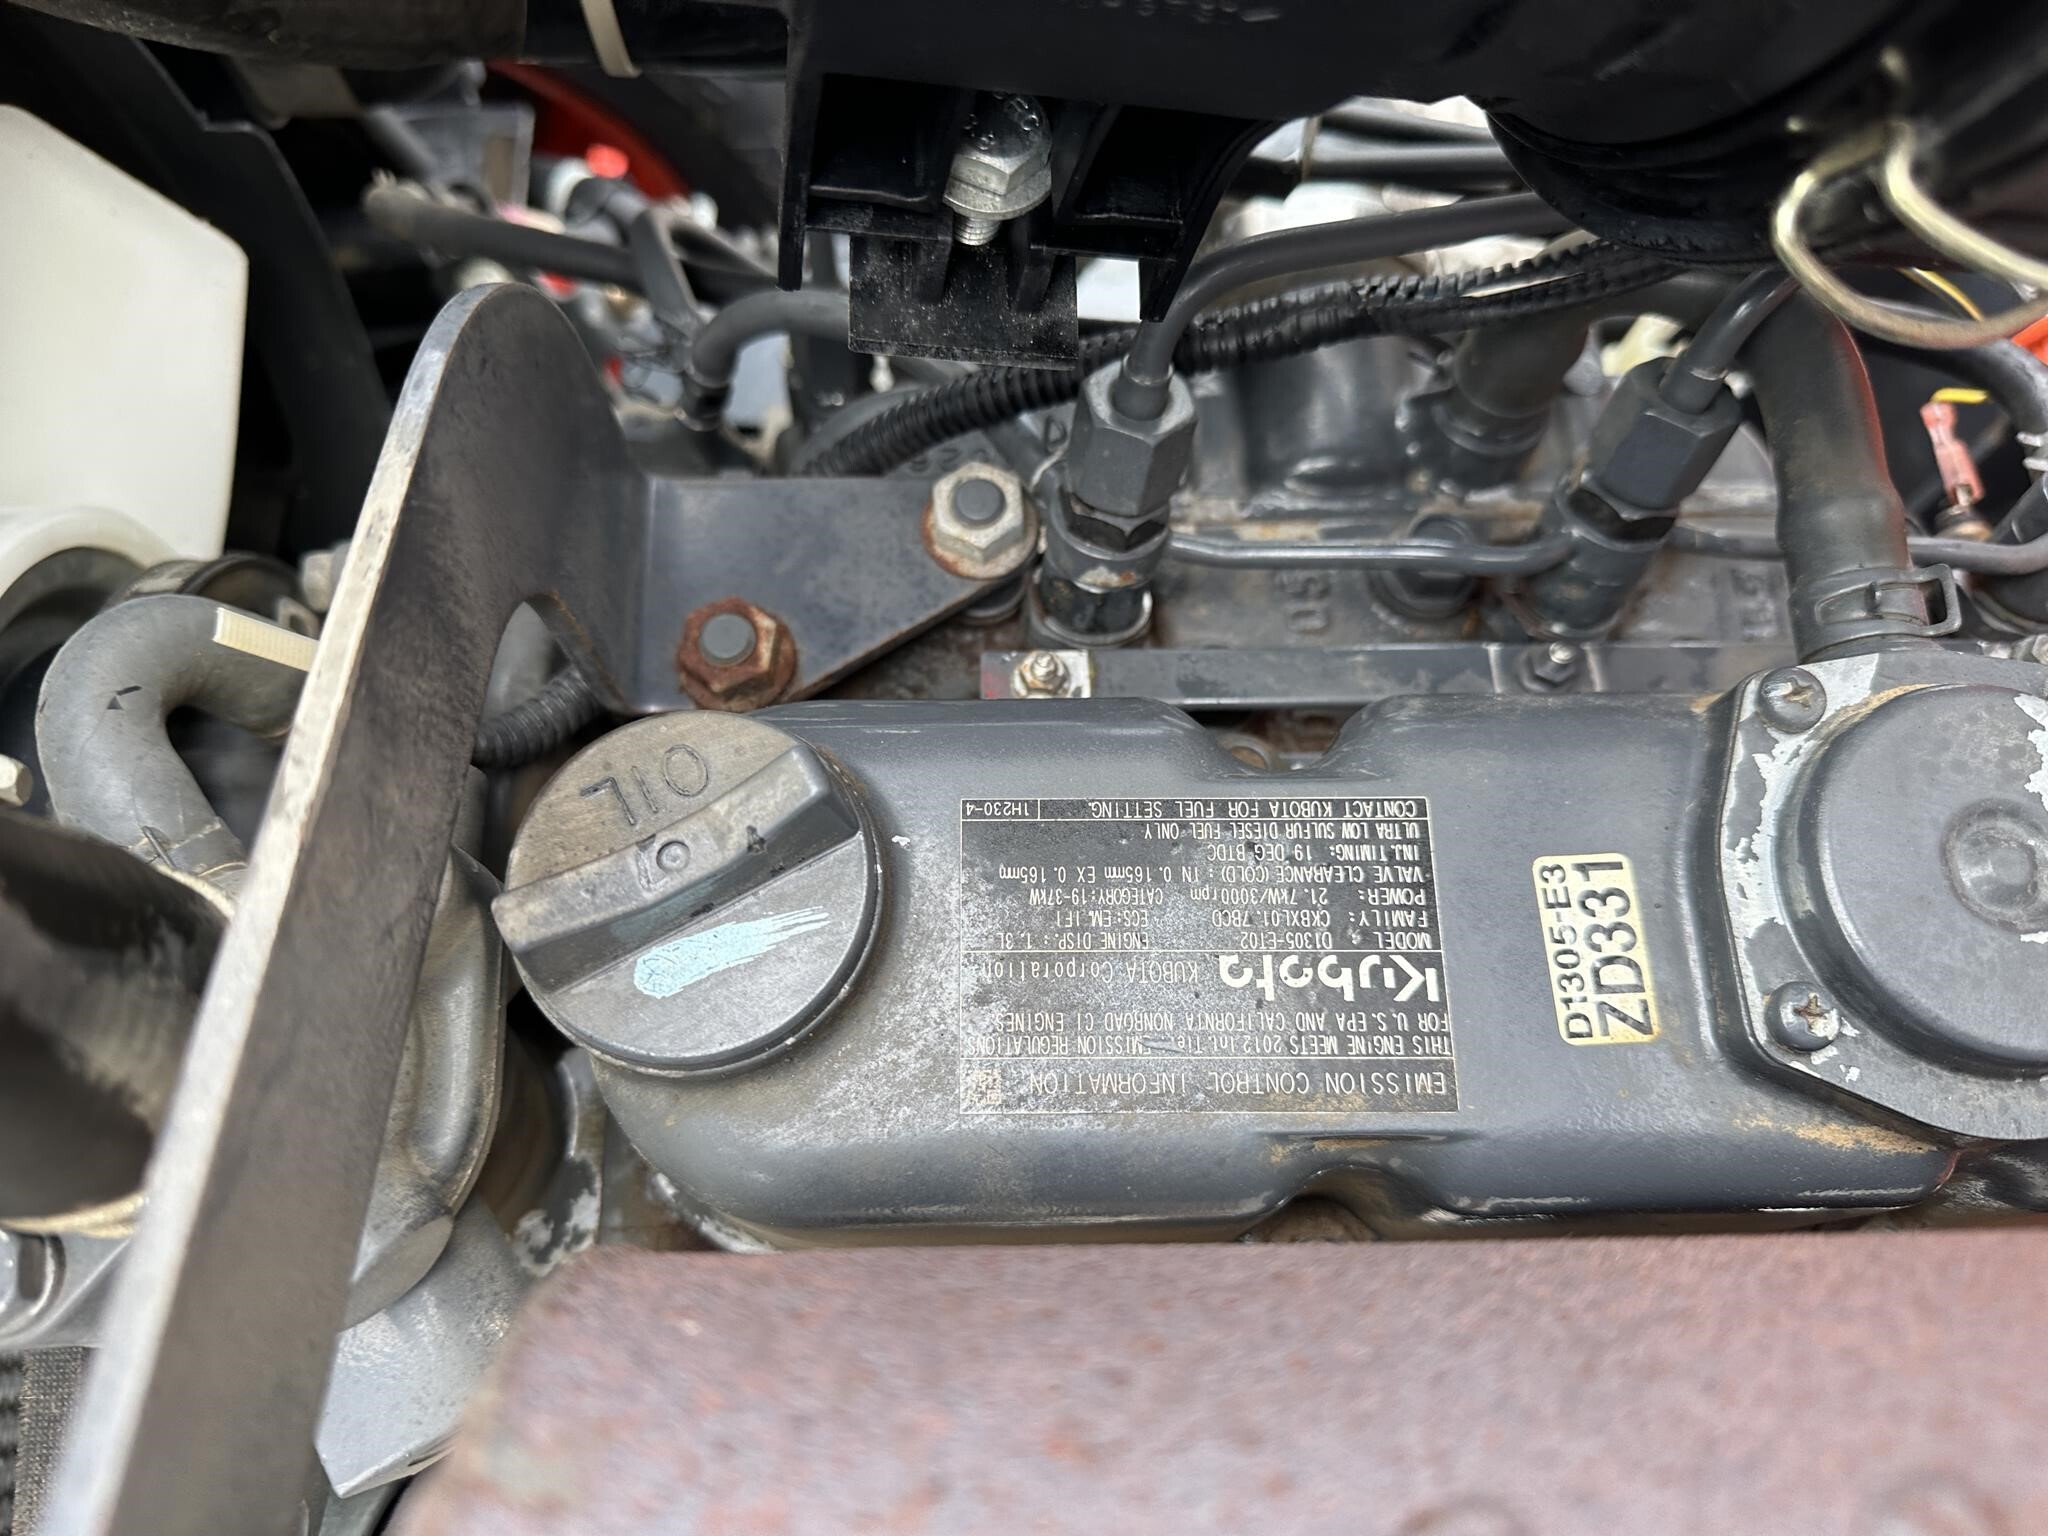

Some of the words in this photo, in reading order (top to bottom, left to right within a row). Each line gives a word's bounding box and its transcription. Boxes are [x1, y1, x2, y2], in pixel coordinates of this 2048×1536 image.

[580, 743, 709, 826] OIL
[964, 801, 1031, 817] 1H230-4
[1174, 799, 1215, 819] FUEL
[1227, 799, 1259, 819] FOR
[1268, 799, 1333, 819] KUBOTA
[1343, 799, 1418, 819] CONTACT
[1143, 821, 1179, 840] ONLY
[1189, 821, 1221, 840] FUEL
[1229, 821, 1279, 840] DIESEL
[1285, 821, 1335, 840] SULFUR
[1341, 821, 1370, 840] LOW
[1375, 821, 1421, 840] ULTRA
[1206, 843, 1246, 862] BTDC
[1253, 843, 1285, 862] DEG
[1293, 843, 1313, 862] 19
[1076, 864, 1096, 883] EX
[1181, 864, 1200, 883] IN
[1373, 864, 1424, 883] VALVE
[1358, 887, 1426, 905] POWER:
[1348, 909, 1428, 928] FAMILY:
[995, 931, 1032, 950] 1.3L
[1100, 931, 1149, 950] ENGINE
[1571, 861, 1655, 1036] ZD331
[1538, 863, 1594, 1039] D1305-E3
[980, 957, 1114, 985] Corporation
[1125, 959, 1199, 983] KUBOTA
[1217, 954, 1440, 1002] Kubota
[1077, 1011, 1094, 1031] CI
[1103, 1011, 1174, 1031] NONROAD
[1184, 1011, 1286, 1031] CALIFORNIA
[1295, 1011, 1325, 1031] AND
[1416, 1011, 1449, 1031] FOR
[967, 1034, 1069, 1055] REGULATIONS
[1242, 1034, 1282, 1055] 2012
[1288, 1034, 1339, 1055] MEETS
[1346, 1034, 1405, 1055] ENGINE
[1411, 1034, 1451, 1055] THIS
[1030, 1071, 1186, 1095] INFORMATION
[1207, 1071, 1311, 1095] CONTROL
[1324, 1071, 1448, 1095] EMISSION
